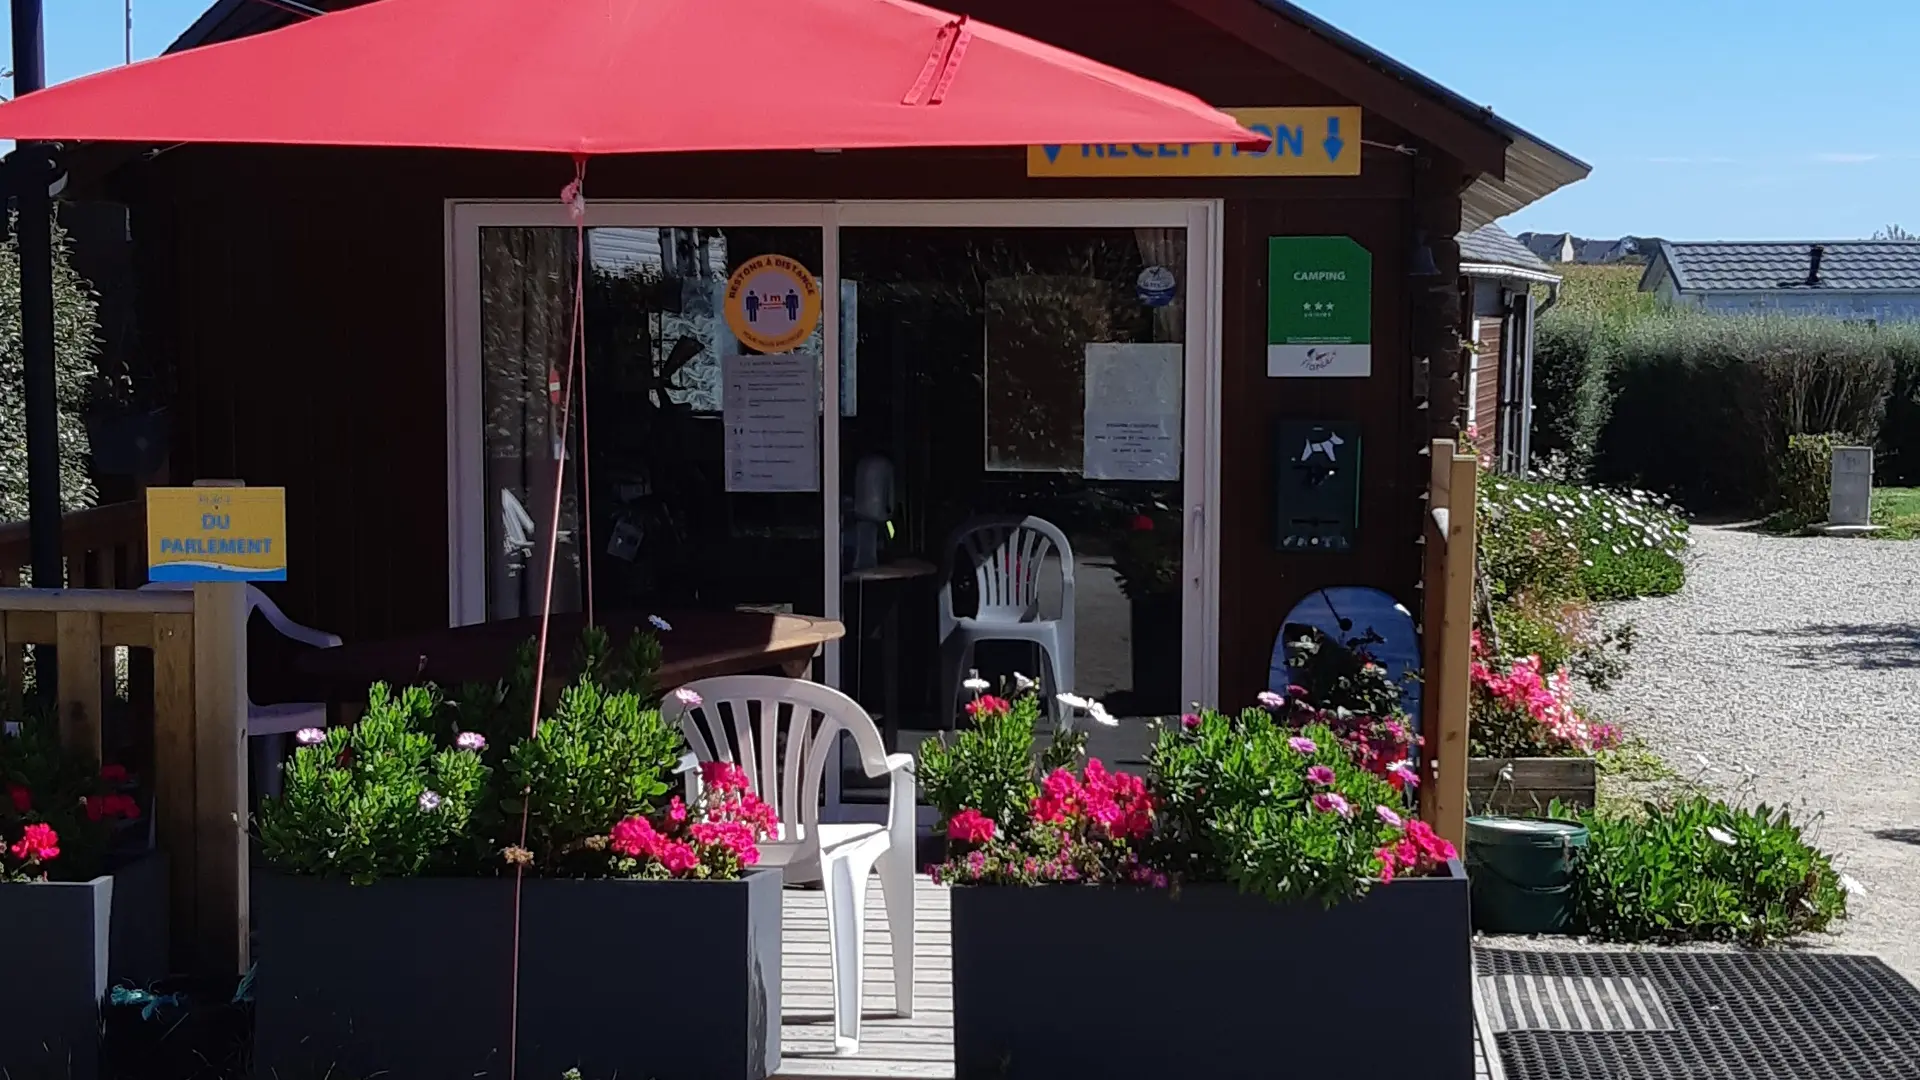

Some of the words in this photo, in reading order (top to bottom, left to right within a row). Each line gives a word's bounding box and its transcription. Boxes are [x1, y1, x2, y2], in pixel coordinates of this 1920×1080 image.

[729, 260, 763, 299] RESTONS
[775, 260, 815, 296] DISTANCE
[1293, 271, 1346, 280] CAMPING
[202, 513, 230, 530] DU
[160, 538, 272, 554] PARLEMENT
